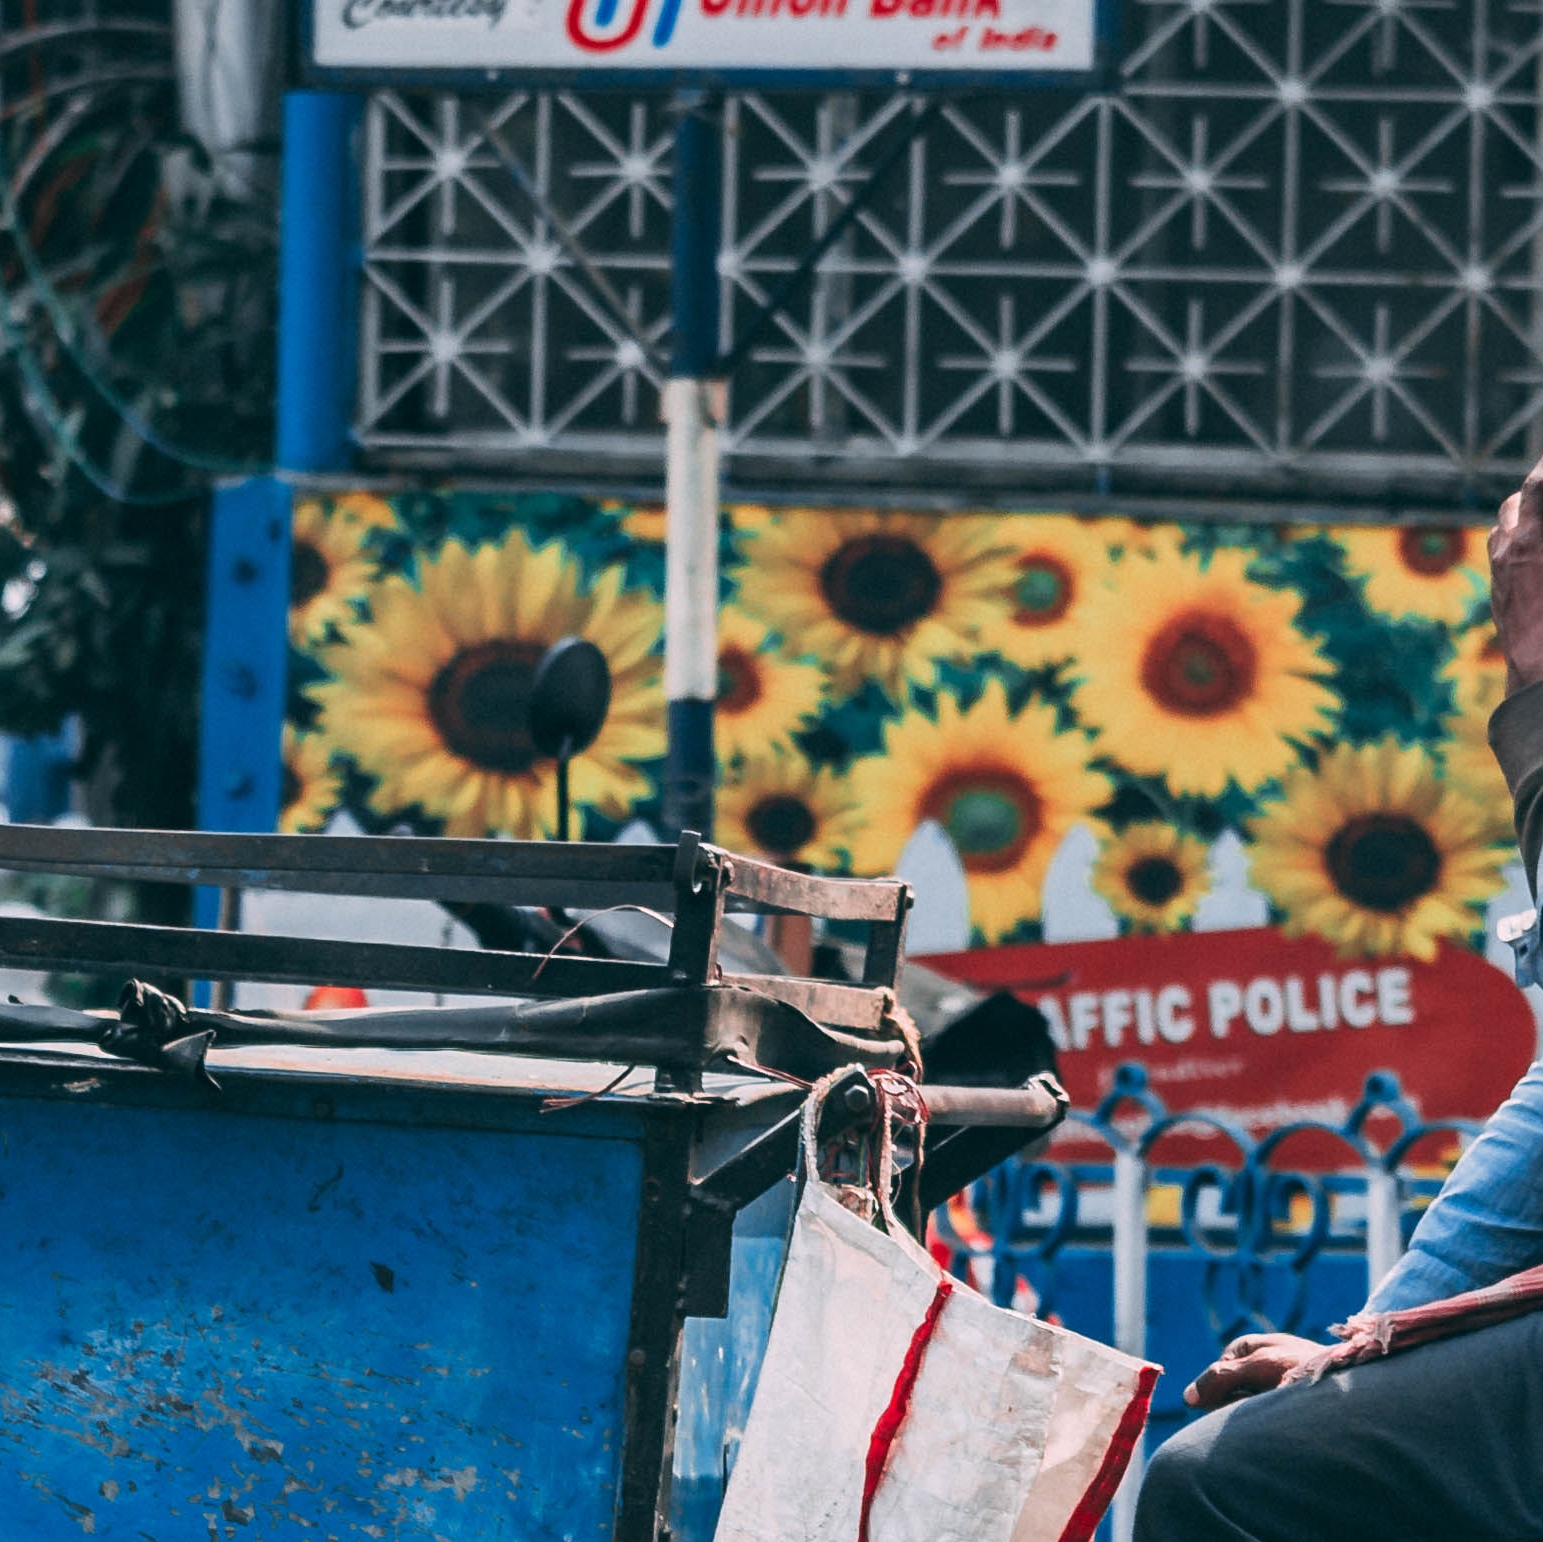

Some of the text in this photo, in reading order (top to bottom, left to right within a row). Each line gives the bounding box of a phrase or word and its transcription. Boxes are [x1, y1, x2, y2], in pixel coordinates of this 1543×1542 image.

[932, 26, 1059, 50] of India
[1038, 966, 1417, 1052] AFFIC POLICE
